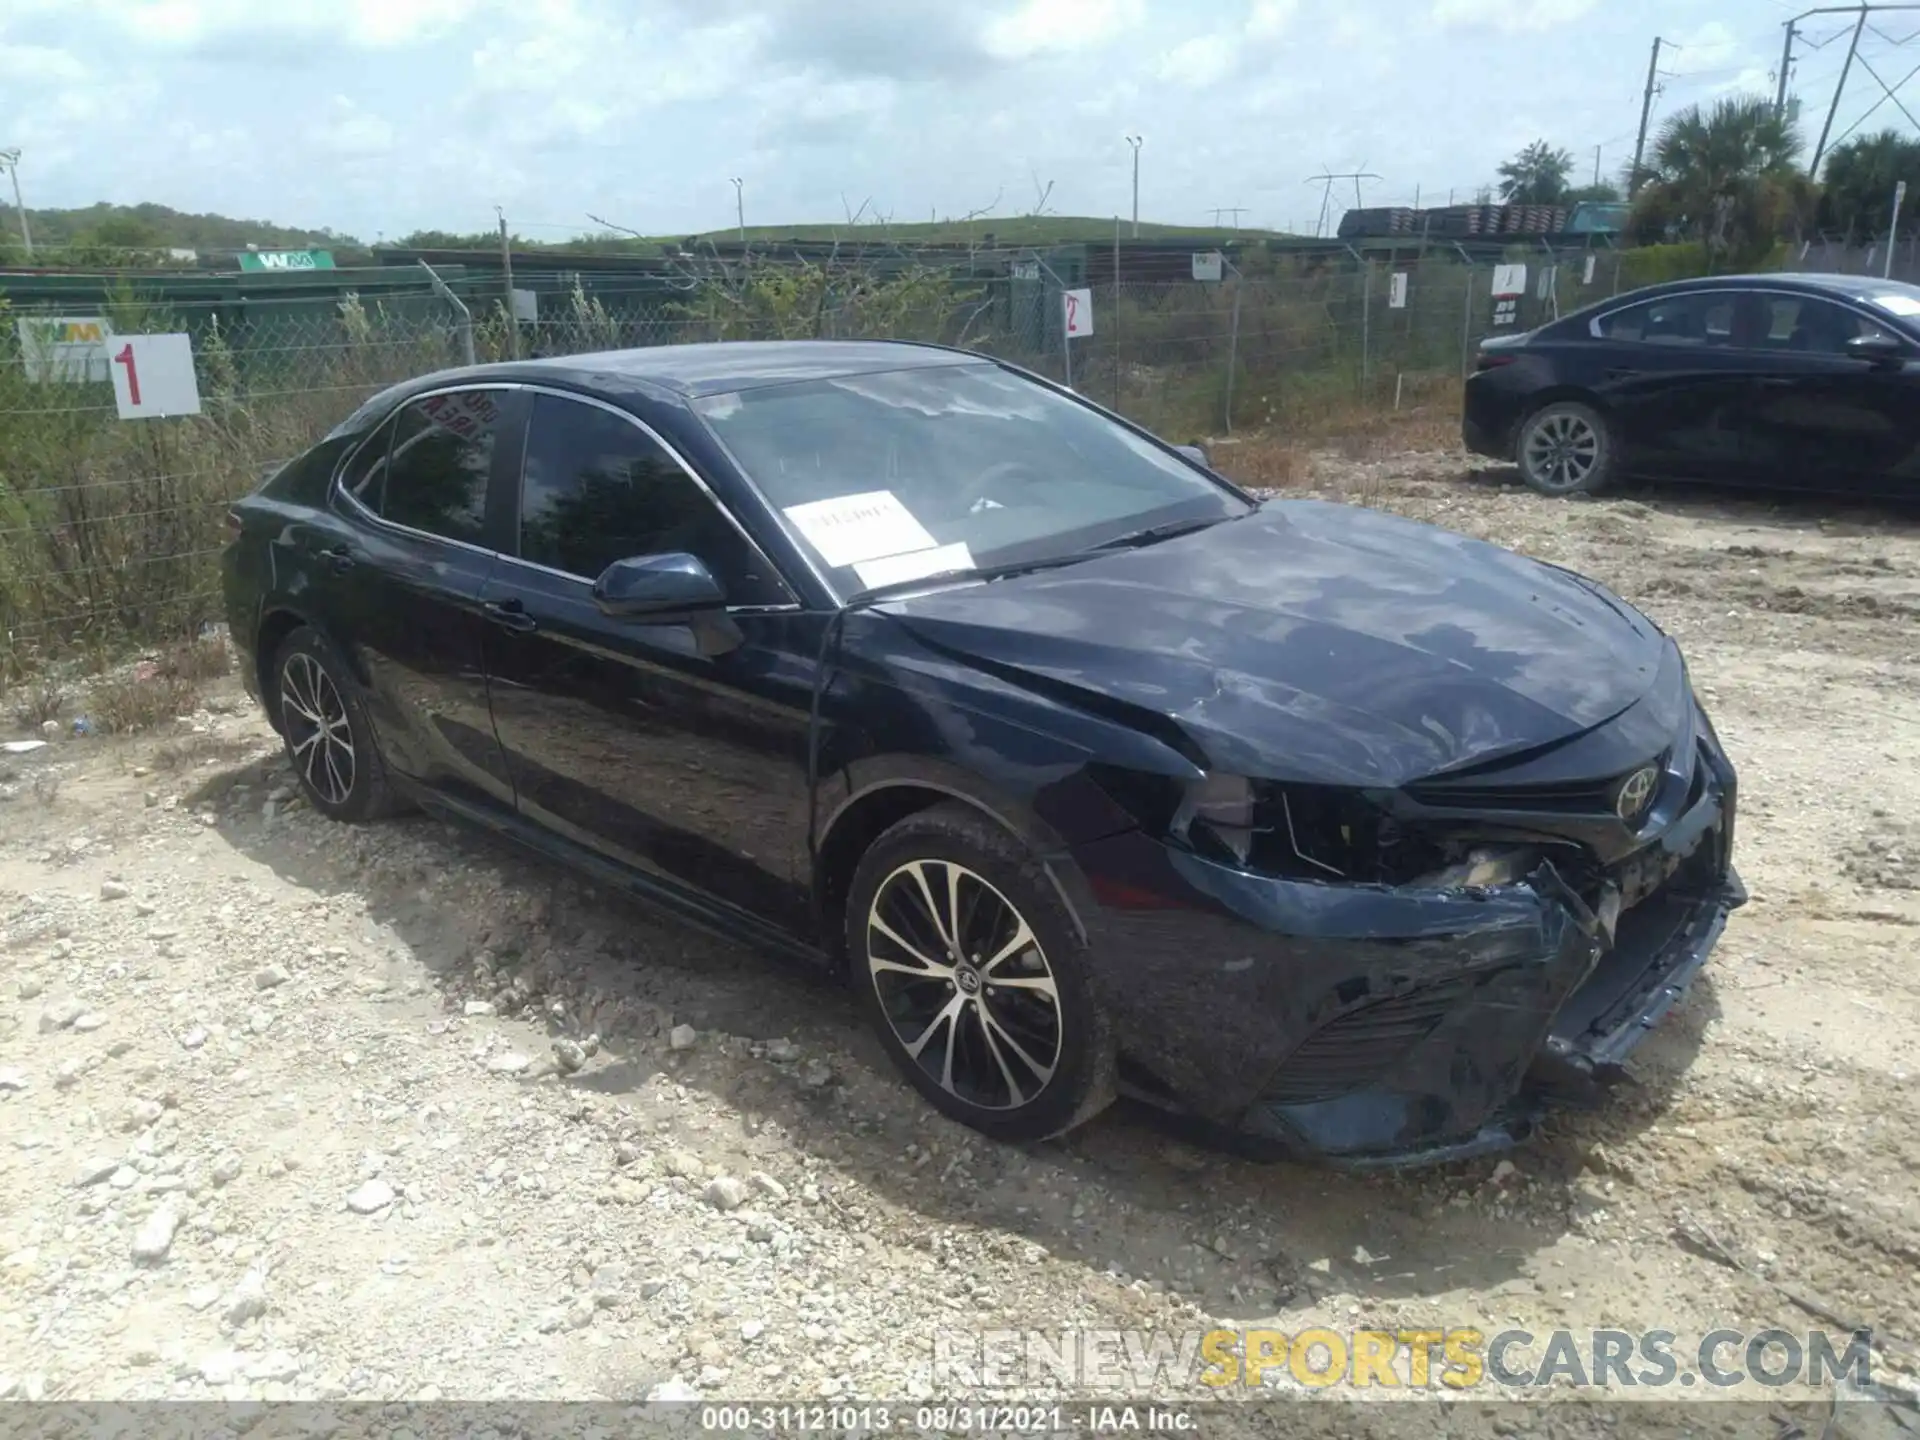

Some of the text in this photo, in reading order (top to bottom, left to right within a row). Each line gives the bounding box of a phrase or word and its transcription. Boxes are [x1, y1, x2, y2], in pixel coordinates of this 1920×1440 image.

[258, 253, 315, 269] WM
[1066, 297, 1080, 331] 2
[114, 343, 141, 405] 1
